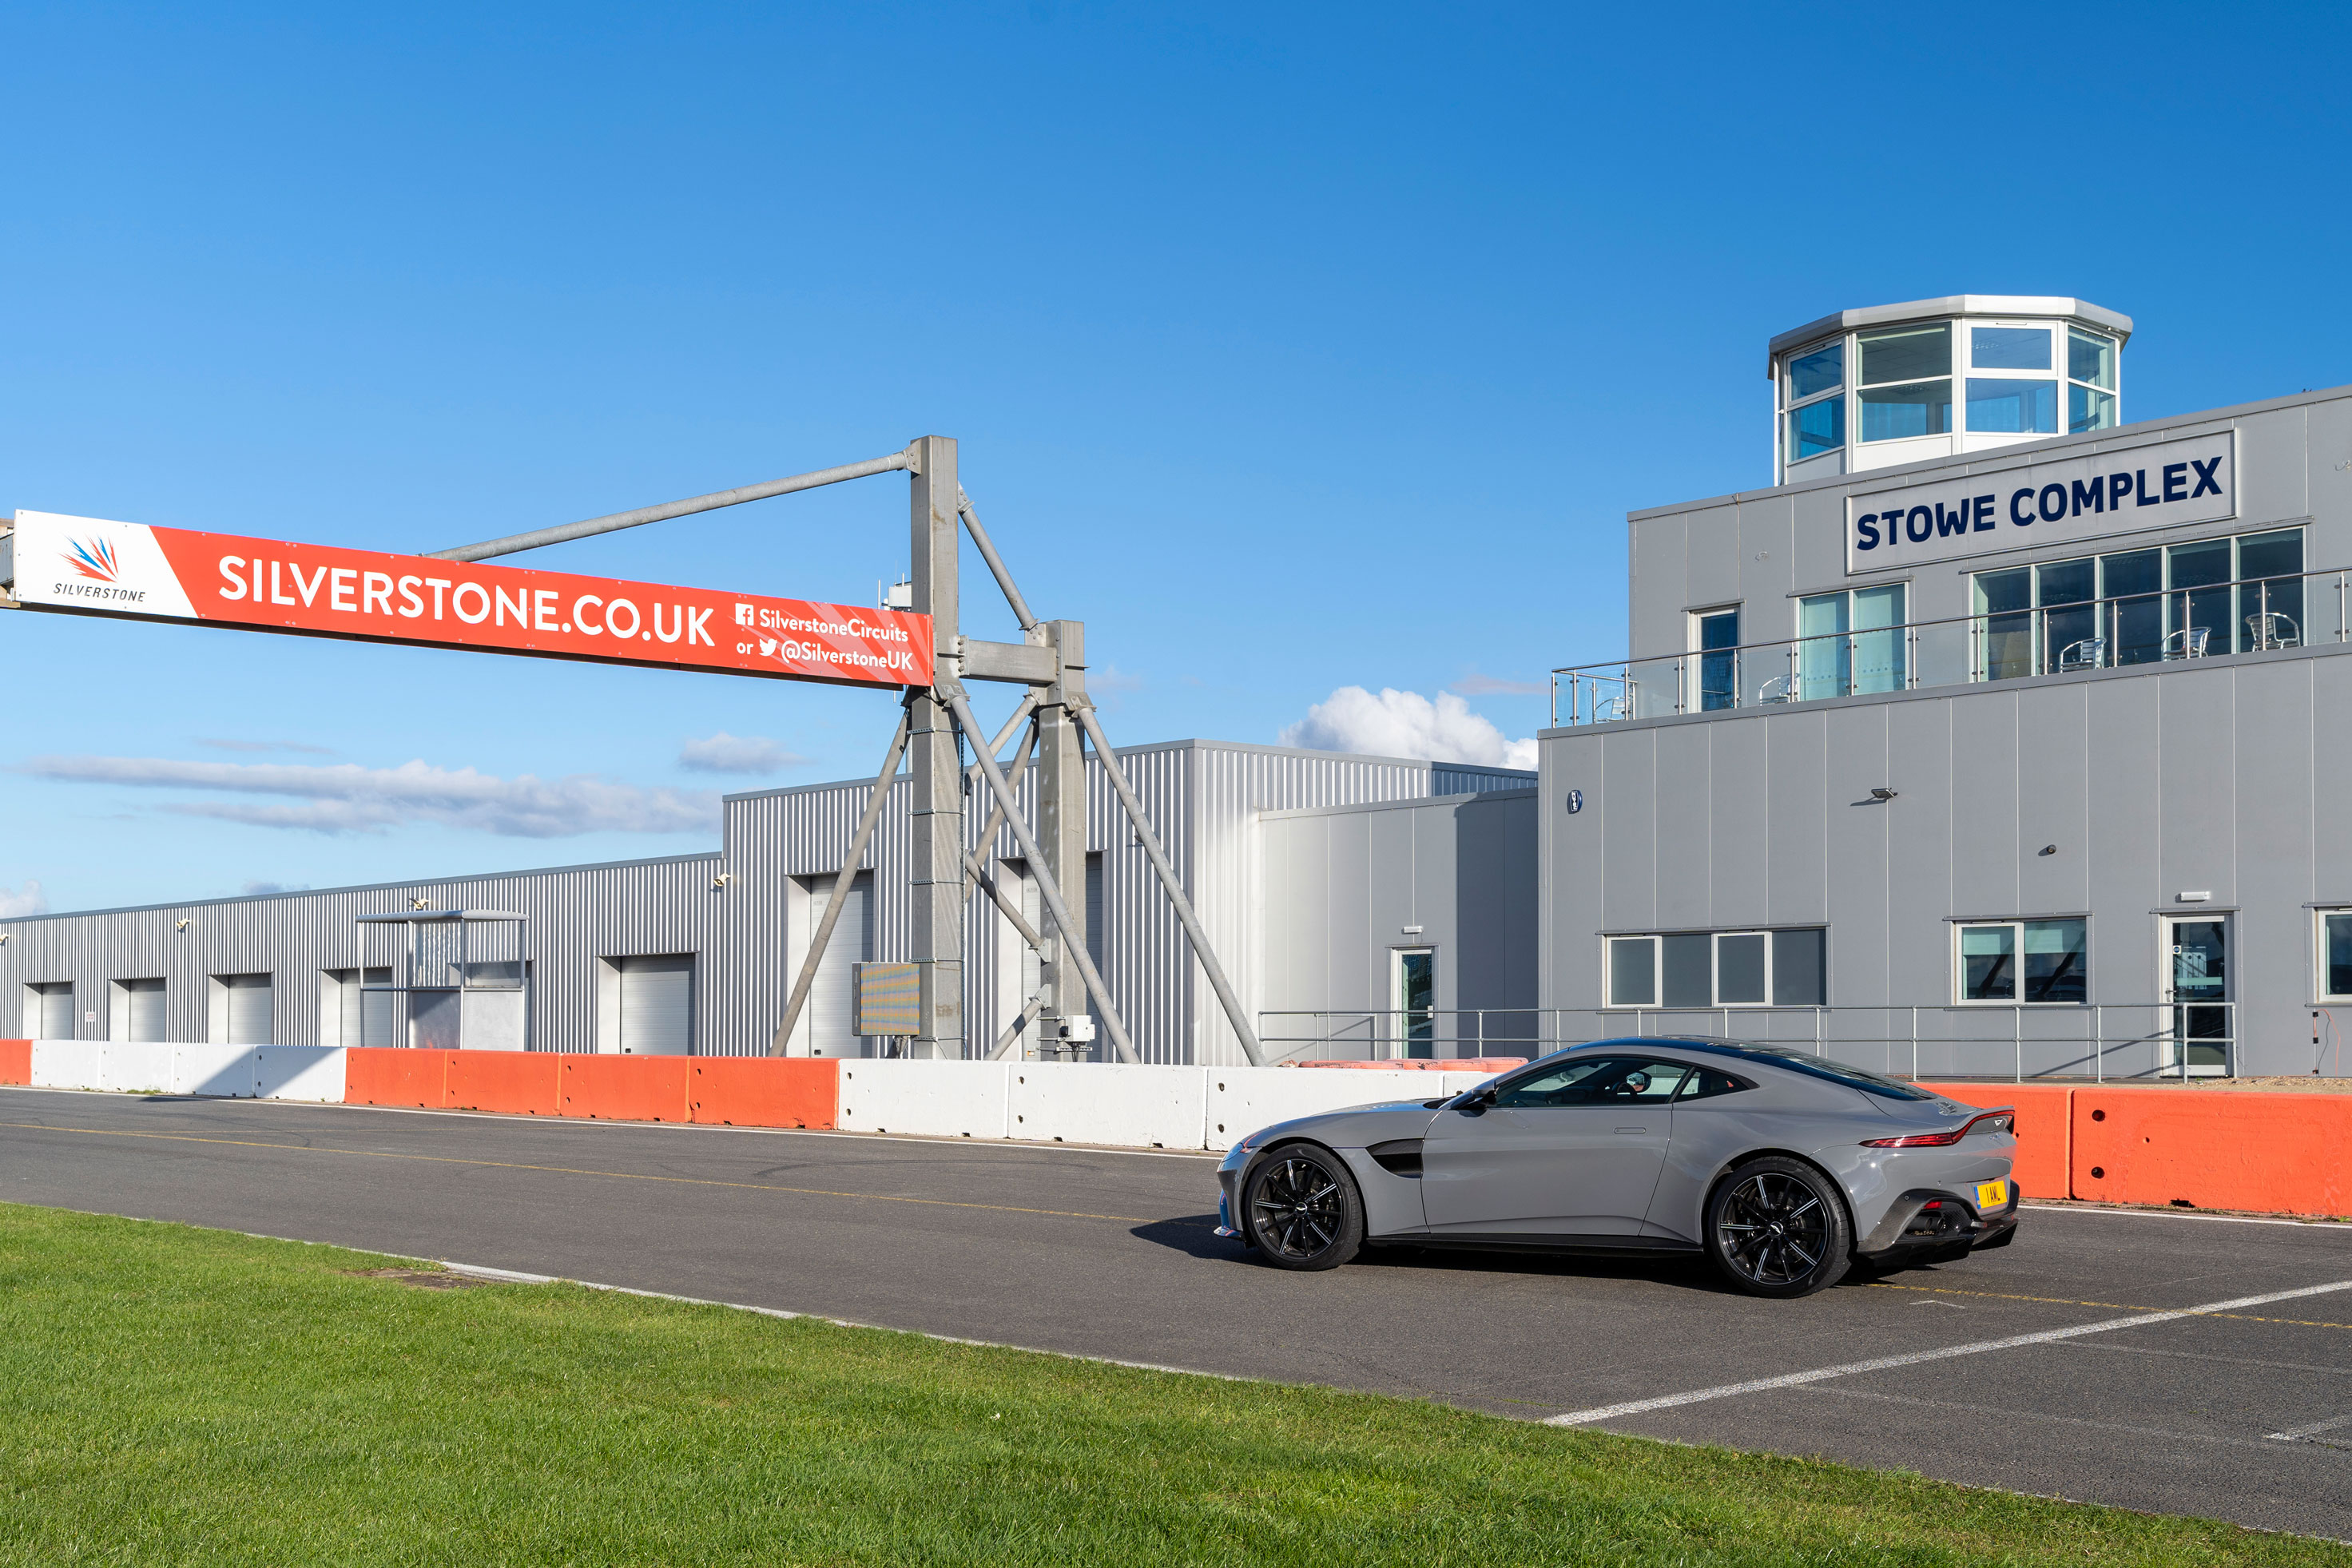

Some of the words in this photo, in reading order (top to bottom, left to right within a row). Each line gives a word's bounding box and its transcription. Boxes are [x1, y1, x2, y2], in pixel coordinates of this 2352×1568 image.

[1856, 494, 1996, 551] STOWE
[2009, 456, 2223, 526] COMPLEX
[53, 582, 145, 602] SILVERSTONE
[218, 555, 716, 647] SILVERSTONE.CO.UK
[760, 608, 908, 642] SilverstoneCircuits
[737, 641, 753, 654] or
[781, 640, 913, 671] @SilverstoneUK
